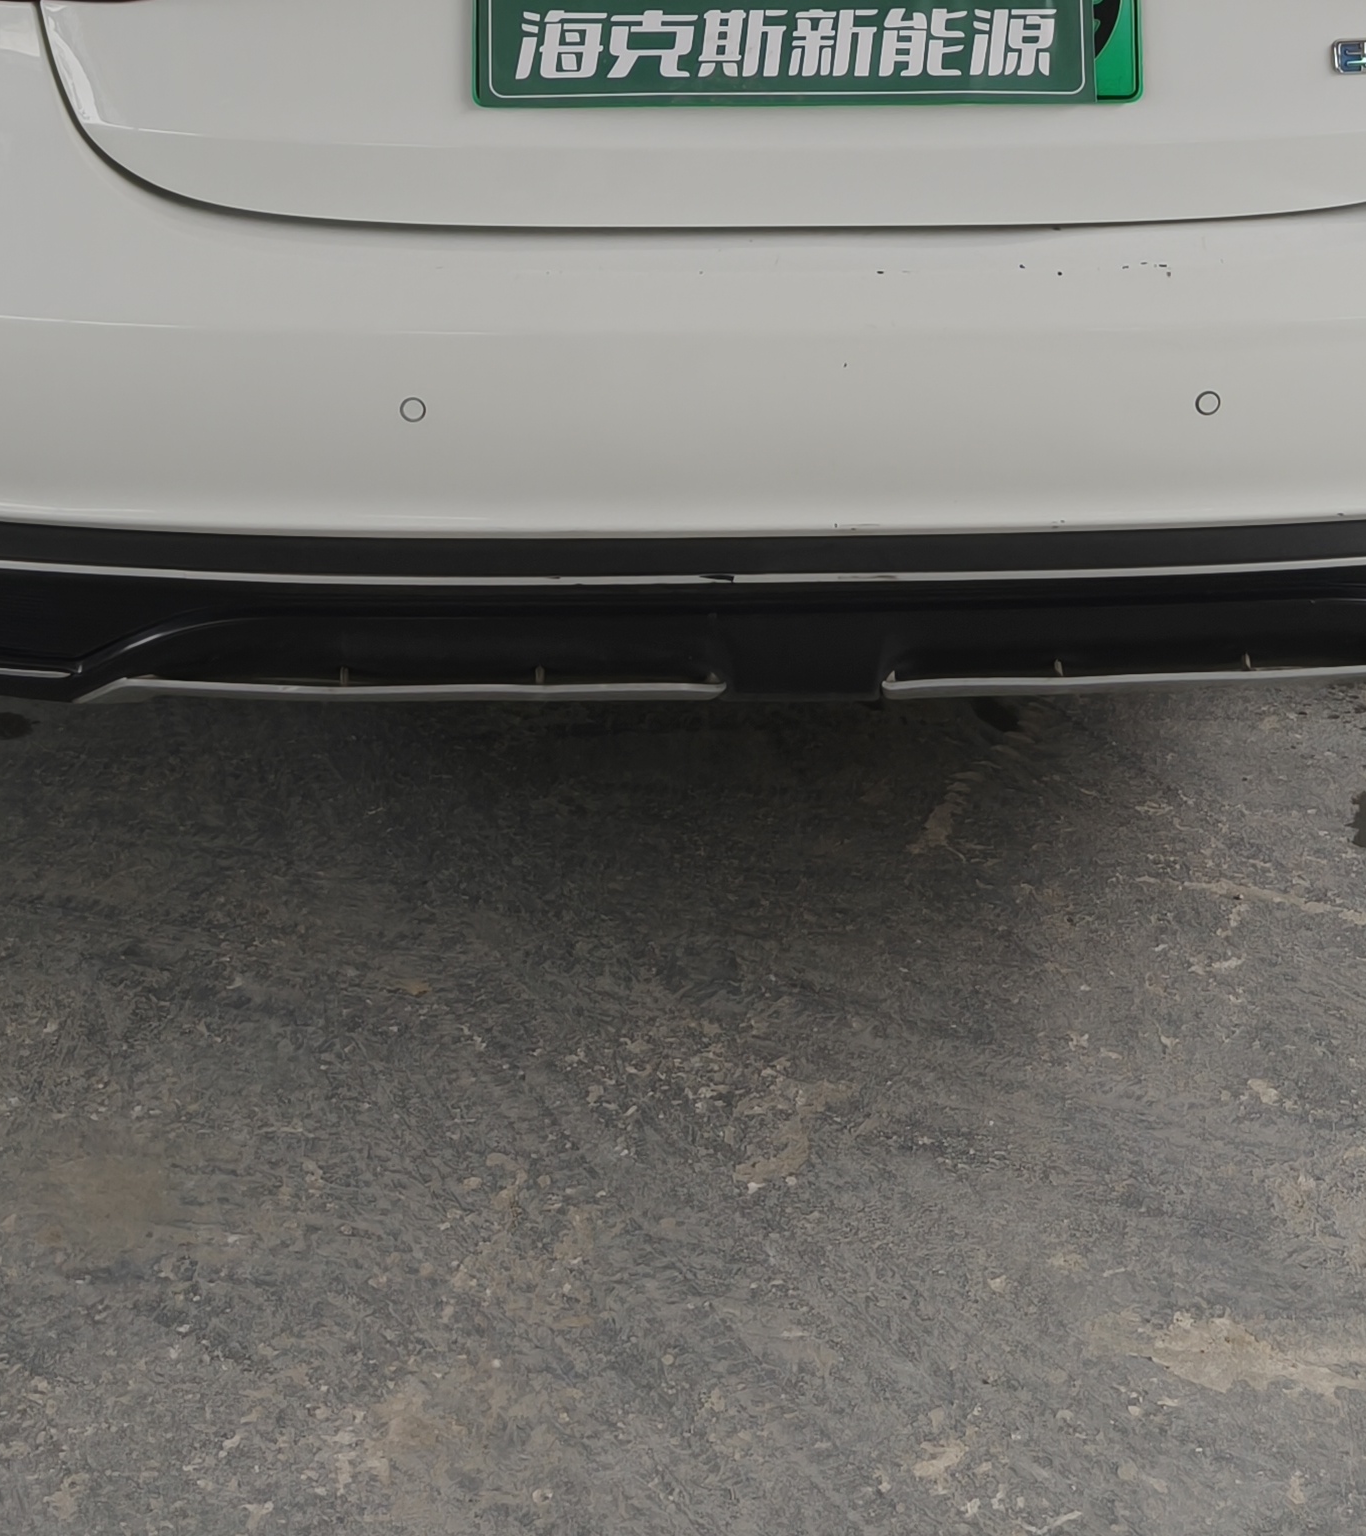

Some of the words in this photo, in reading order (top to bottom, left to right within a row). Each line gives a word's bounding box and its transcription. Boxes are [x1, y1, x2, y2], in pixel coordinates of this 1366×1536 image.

[514, 7, 1058, 80] 海克斯新能源
